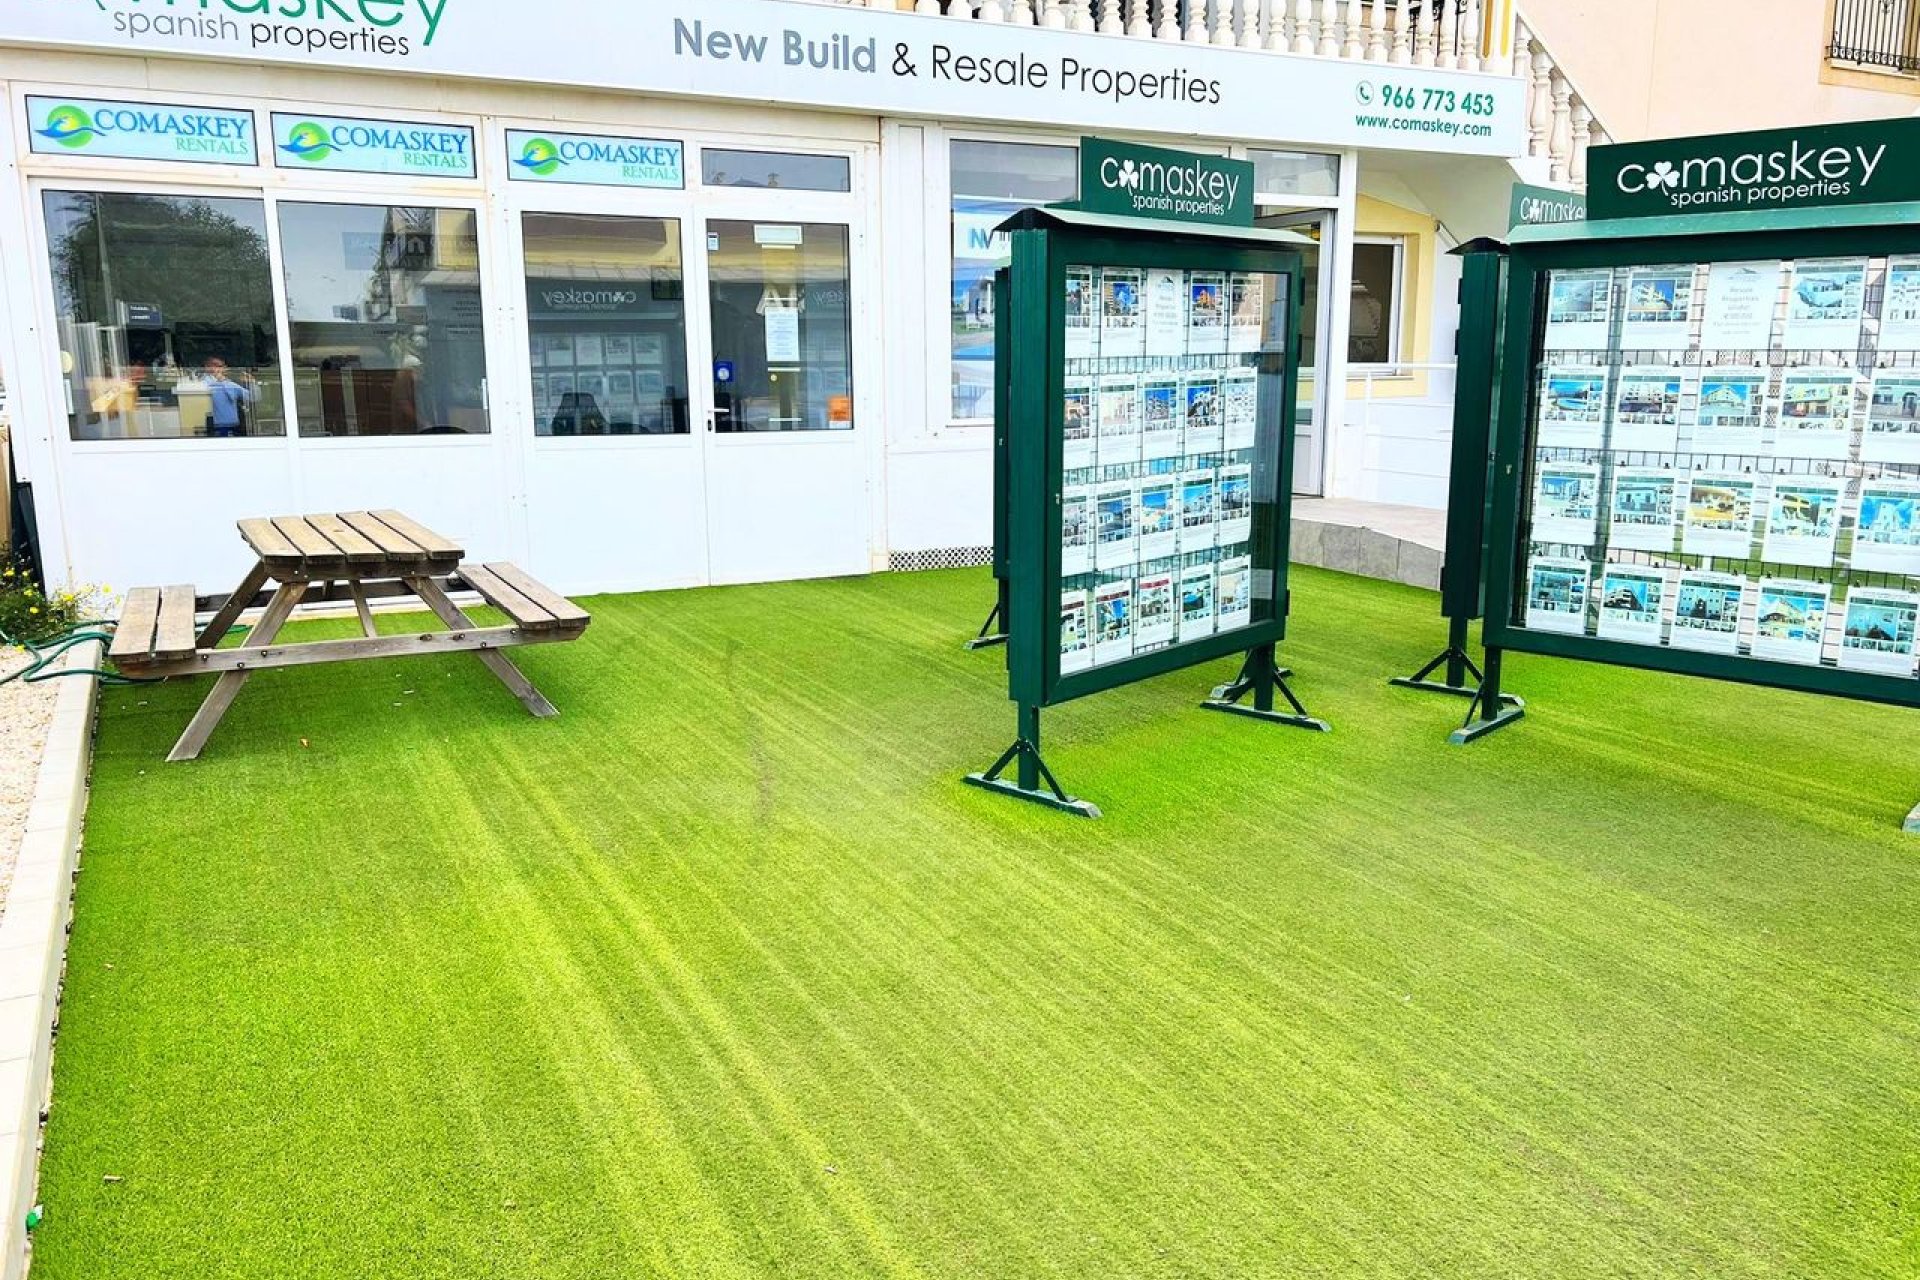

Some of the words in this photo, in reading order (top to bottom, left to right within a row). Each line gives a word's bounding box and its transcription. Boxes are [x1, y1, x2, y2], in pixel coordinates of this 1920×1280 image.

[113, 11, 239, 40] spanish
[251, 23, 410, 55] properties
[674, 18, 768, 62] New
[783, 29, 876, 73] Build
[892, 43, 917, 76] &
[932, 45, 1048, 88] Resale
[1061, 58, 1220, 104] Properties
[1382, 84, 1415, 109] 966
[1423, 88, 1455, 112] 773
[1461, 92, 1494, 115] 453
[94, 108, 249, 139] COMASKEY
[1355, 115, 1492, 136] www.comaskey.com
[176, 137, 249, 155] RENTALS
[332, 126, 468, 154] COMASKEY
[404, 153, 468, 168] RENTALS
[560, 141, 679, 166] COMASKEY
[623, 166, 679, 181] RENTALS
[1132, 194, 1173, 211] spanish
[1176, 199, 1225, 215] properties
[1670, 186, 1741, 208] spanish
[1747, 180, 1851, 204] properties
